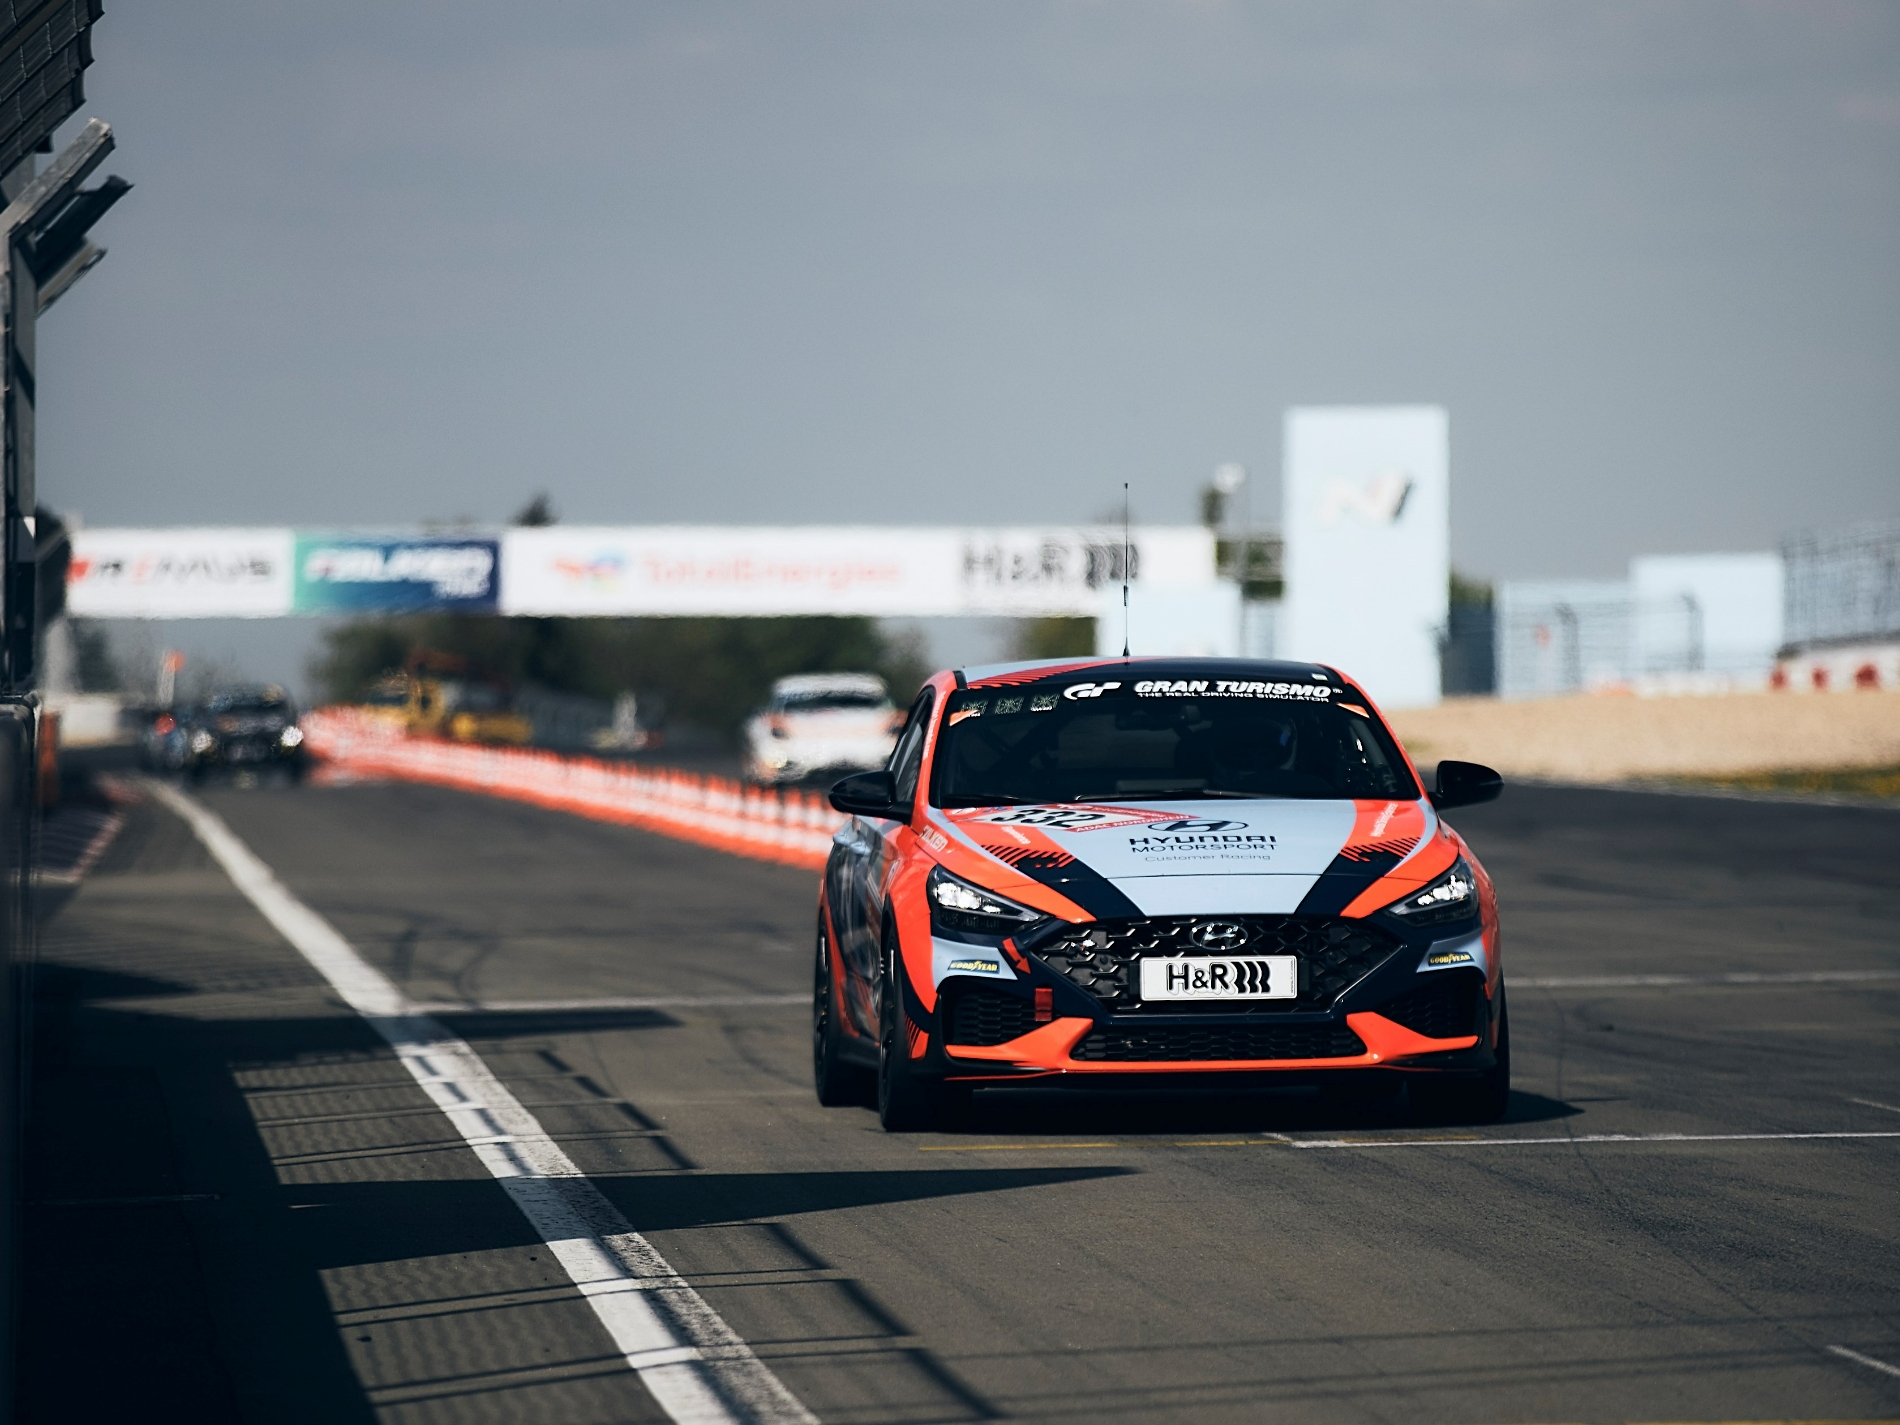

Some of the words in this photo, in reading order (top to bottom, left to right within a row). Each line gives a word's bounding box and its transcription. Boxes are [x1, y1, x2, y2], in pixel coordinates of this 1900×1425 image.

[1134, 680, 1209, 692] GRAN
[1215, 681, 1332, 697] TURISMO
[1256, 693, 1330, 702] SIMULATOR
[990, 808, 1106, 828] 332
[1129, 835, 1277, 845] HYUNDAI
[1131, 844, 1278, 853] MOTORSPORT
[1145, 854, 1216, 862] Customer
[1220, 853, 1271, 861] Racing
[1166, 962, 1231, 992] H&R
